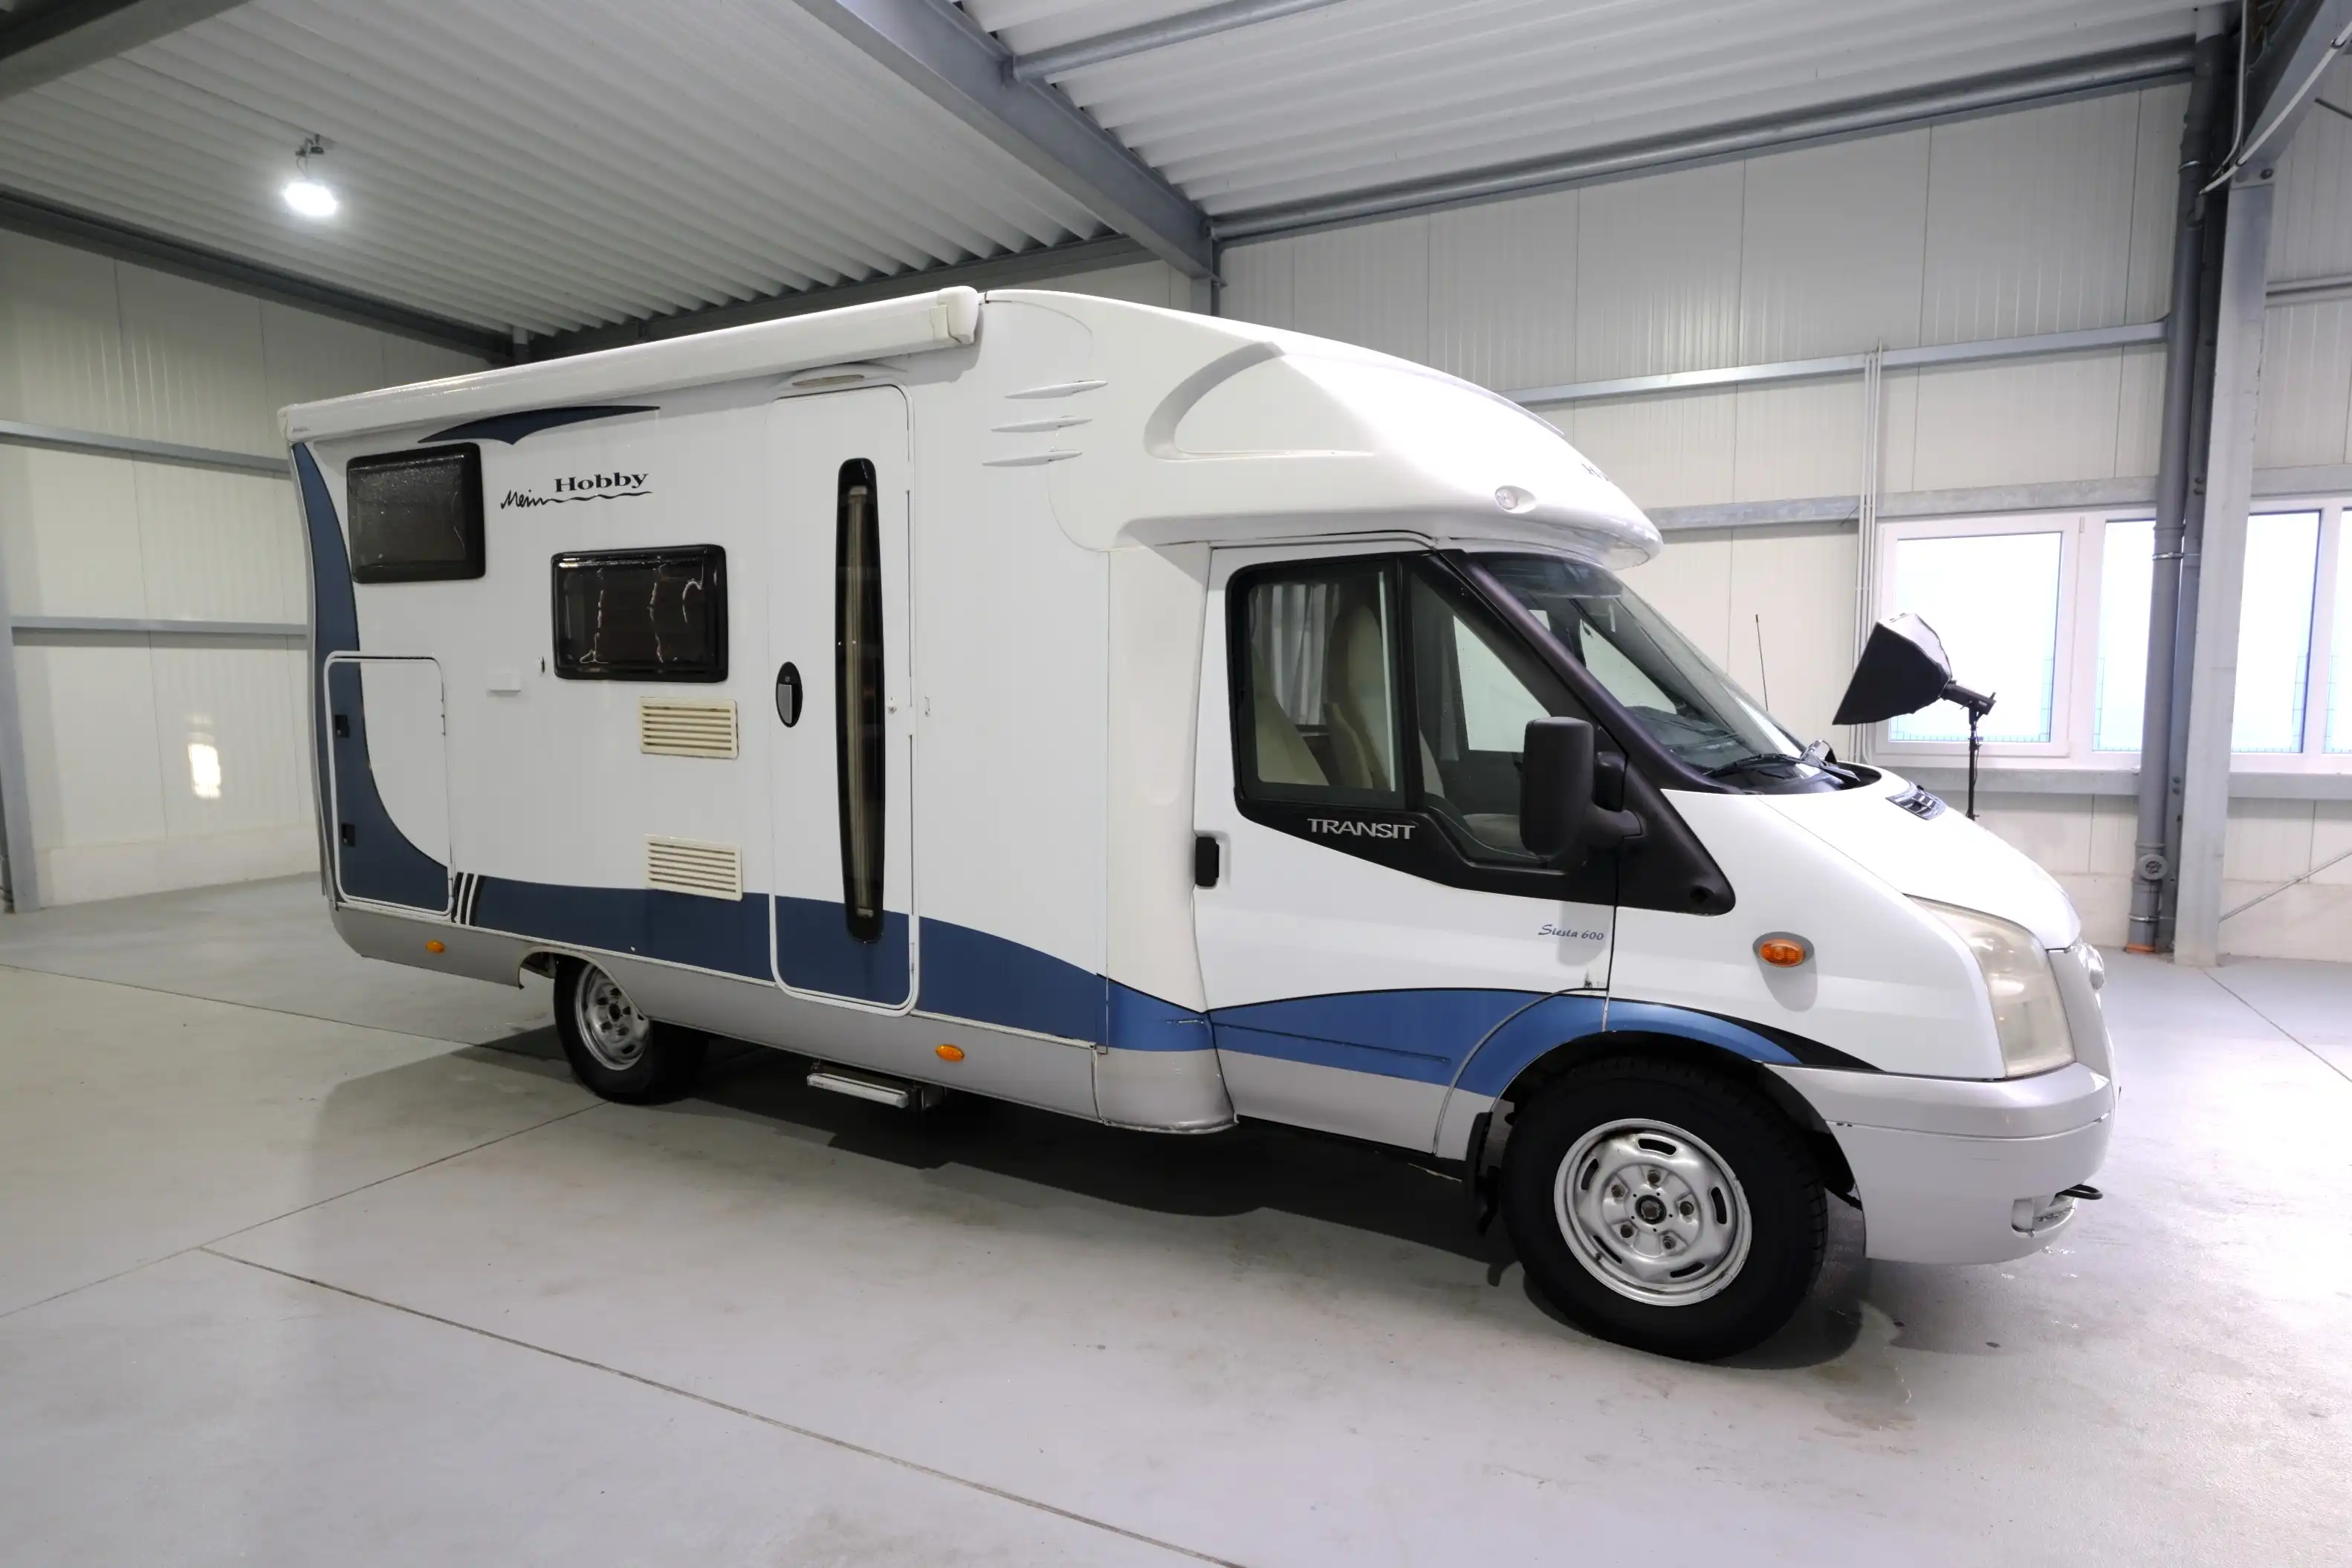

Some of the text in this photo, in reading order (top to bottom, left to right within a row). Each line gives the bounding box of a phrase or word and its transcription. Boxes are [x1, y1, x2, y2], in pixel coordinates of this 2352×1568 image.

[500, 472, 648, 509] Mein Hobby
[1307, 818, 1416, 840] TRANSIT
[1538, 924, 1604, 941] Siesta 600
